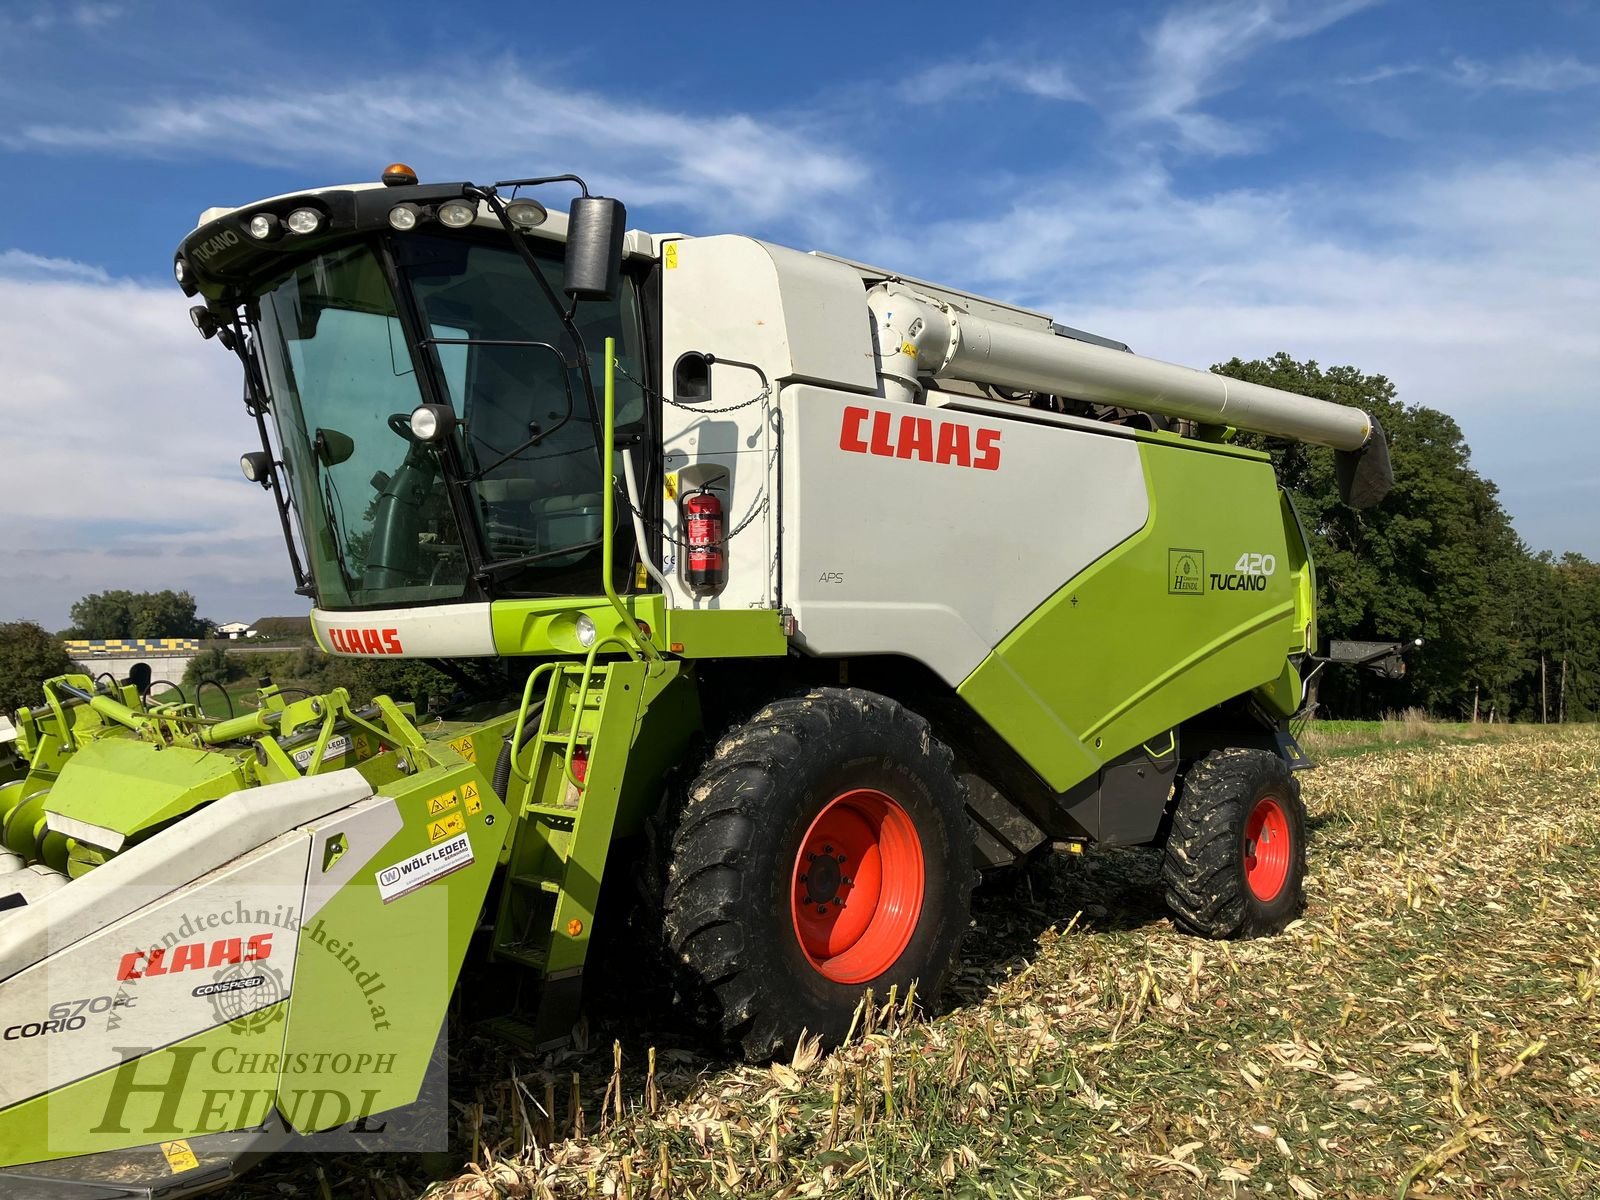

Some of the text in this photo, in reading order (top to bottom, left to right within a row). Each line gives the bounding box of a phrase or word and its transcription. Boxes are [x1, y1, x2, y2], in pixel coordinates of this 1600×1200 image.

[192, 229, 239, 263] TUCANO
[840, 406, 1001, 471] CLAAS
[1234, 553, 1276, 576] 420
[819, 572, 844, 584] APS
[1210, 573, 1267, 592] TUCANO
[328, 628, 404, 655] CLAAS
[400, 838, 468, 875] WÖLFLEDER
[117, 932, 274, 982] CLAAS
[196, 977, 261, 995] CONSPEED
[3, 1015, 86, 1041] CORIO
